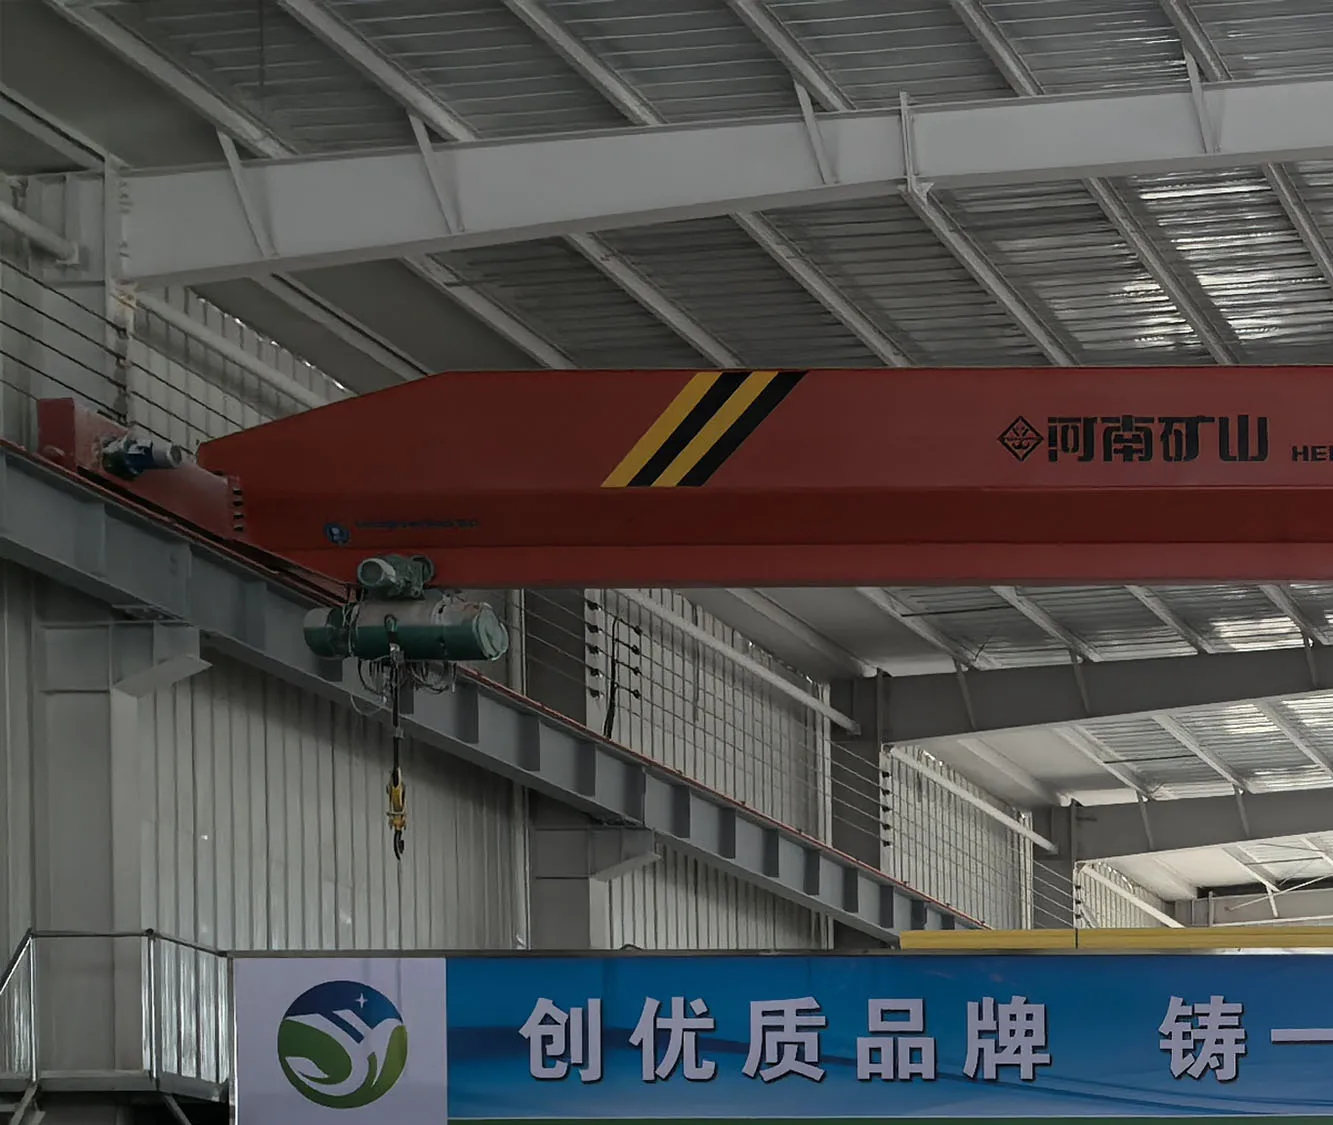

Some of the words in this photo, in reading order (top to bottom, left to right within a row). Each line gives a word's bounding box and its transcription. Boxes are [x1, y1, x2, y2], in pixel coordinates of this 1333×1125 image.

[1048, 414, 1268, 463] 河南矿山
[519, 995, 1051, 1082] 创优质品牌
